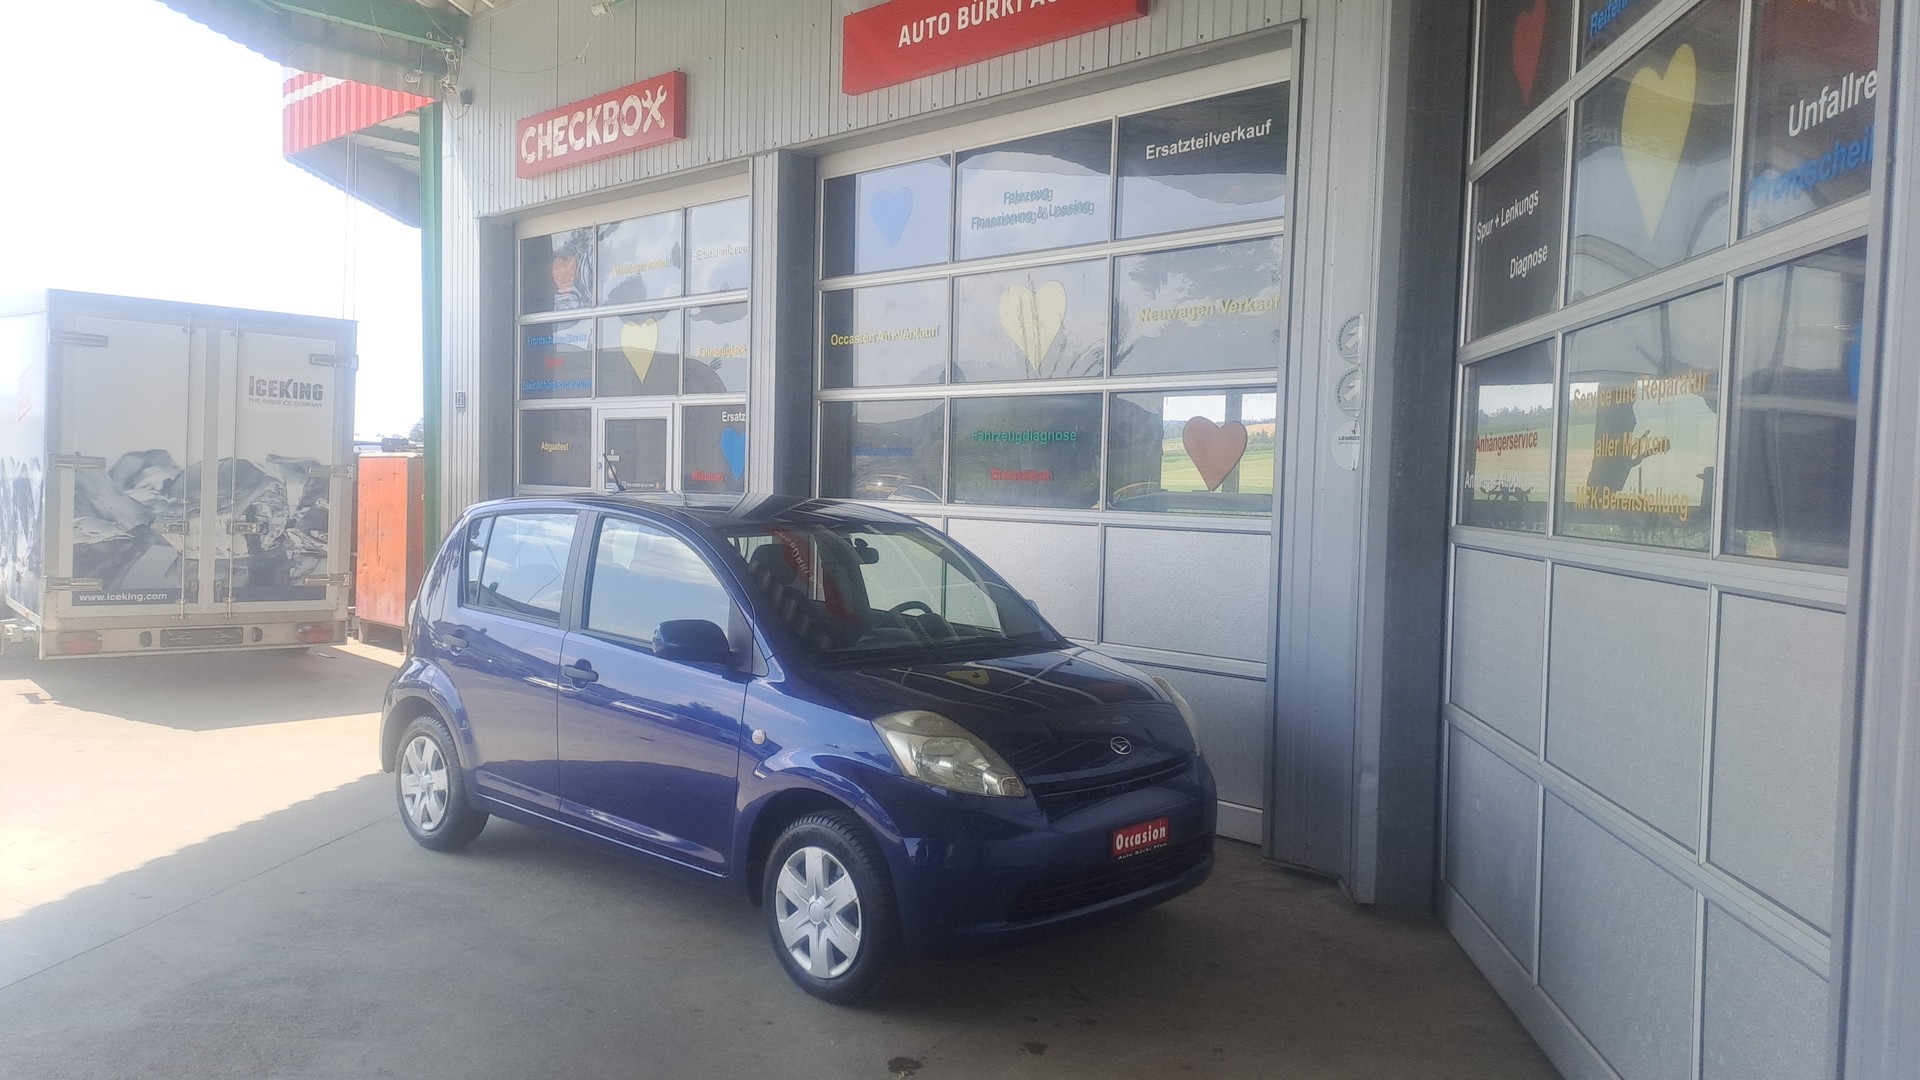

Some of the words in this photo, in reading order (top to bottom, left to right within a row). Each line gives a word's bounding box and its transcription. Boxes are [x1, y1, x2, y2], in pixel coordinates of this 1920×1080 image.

[898, 12, 950, 48] AUTO
[1788, 70, 1876, 137] Unfallre
[521, 85, 668, 164] CHECKBOX
[1146, 119, 1272, 160] Ersatzteilverkauf
[1477, 219, 1494, 243] Spur
[1501, 190, 1539, 227] Lenkungs
[1510, 245, 1548, 279] Diagnose
[1139, 303, 1216, 322] Neuwagen
[721, 411, 746, 423] Ersatz
[971, 428, 1077, 445] Fahrzeugdiagnose
[1476, 428, 1538, 457] Anhängerservice
[1115, 825, 1166, 851] Occasion
